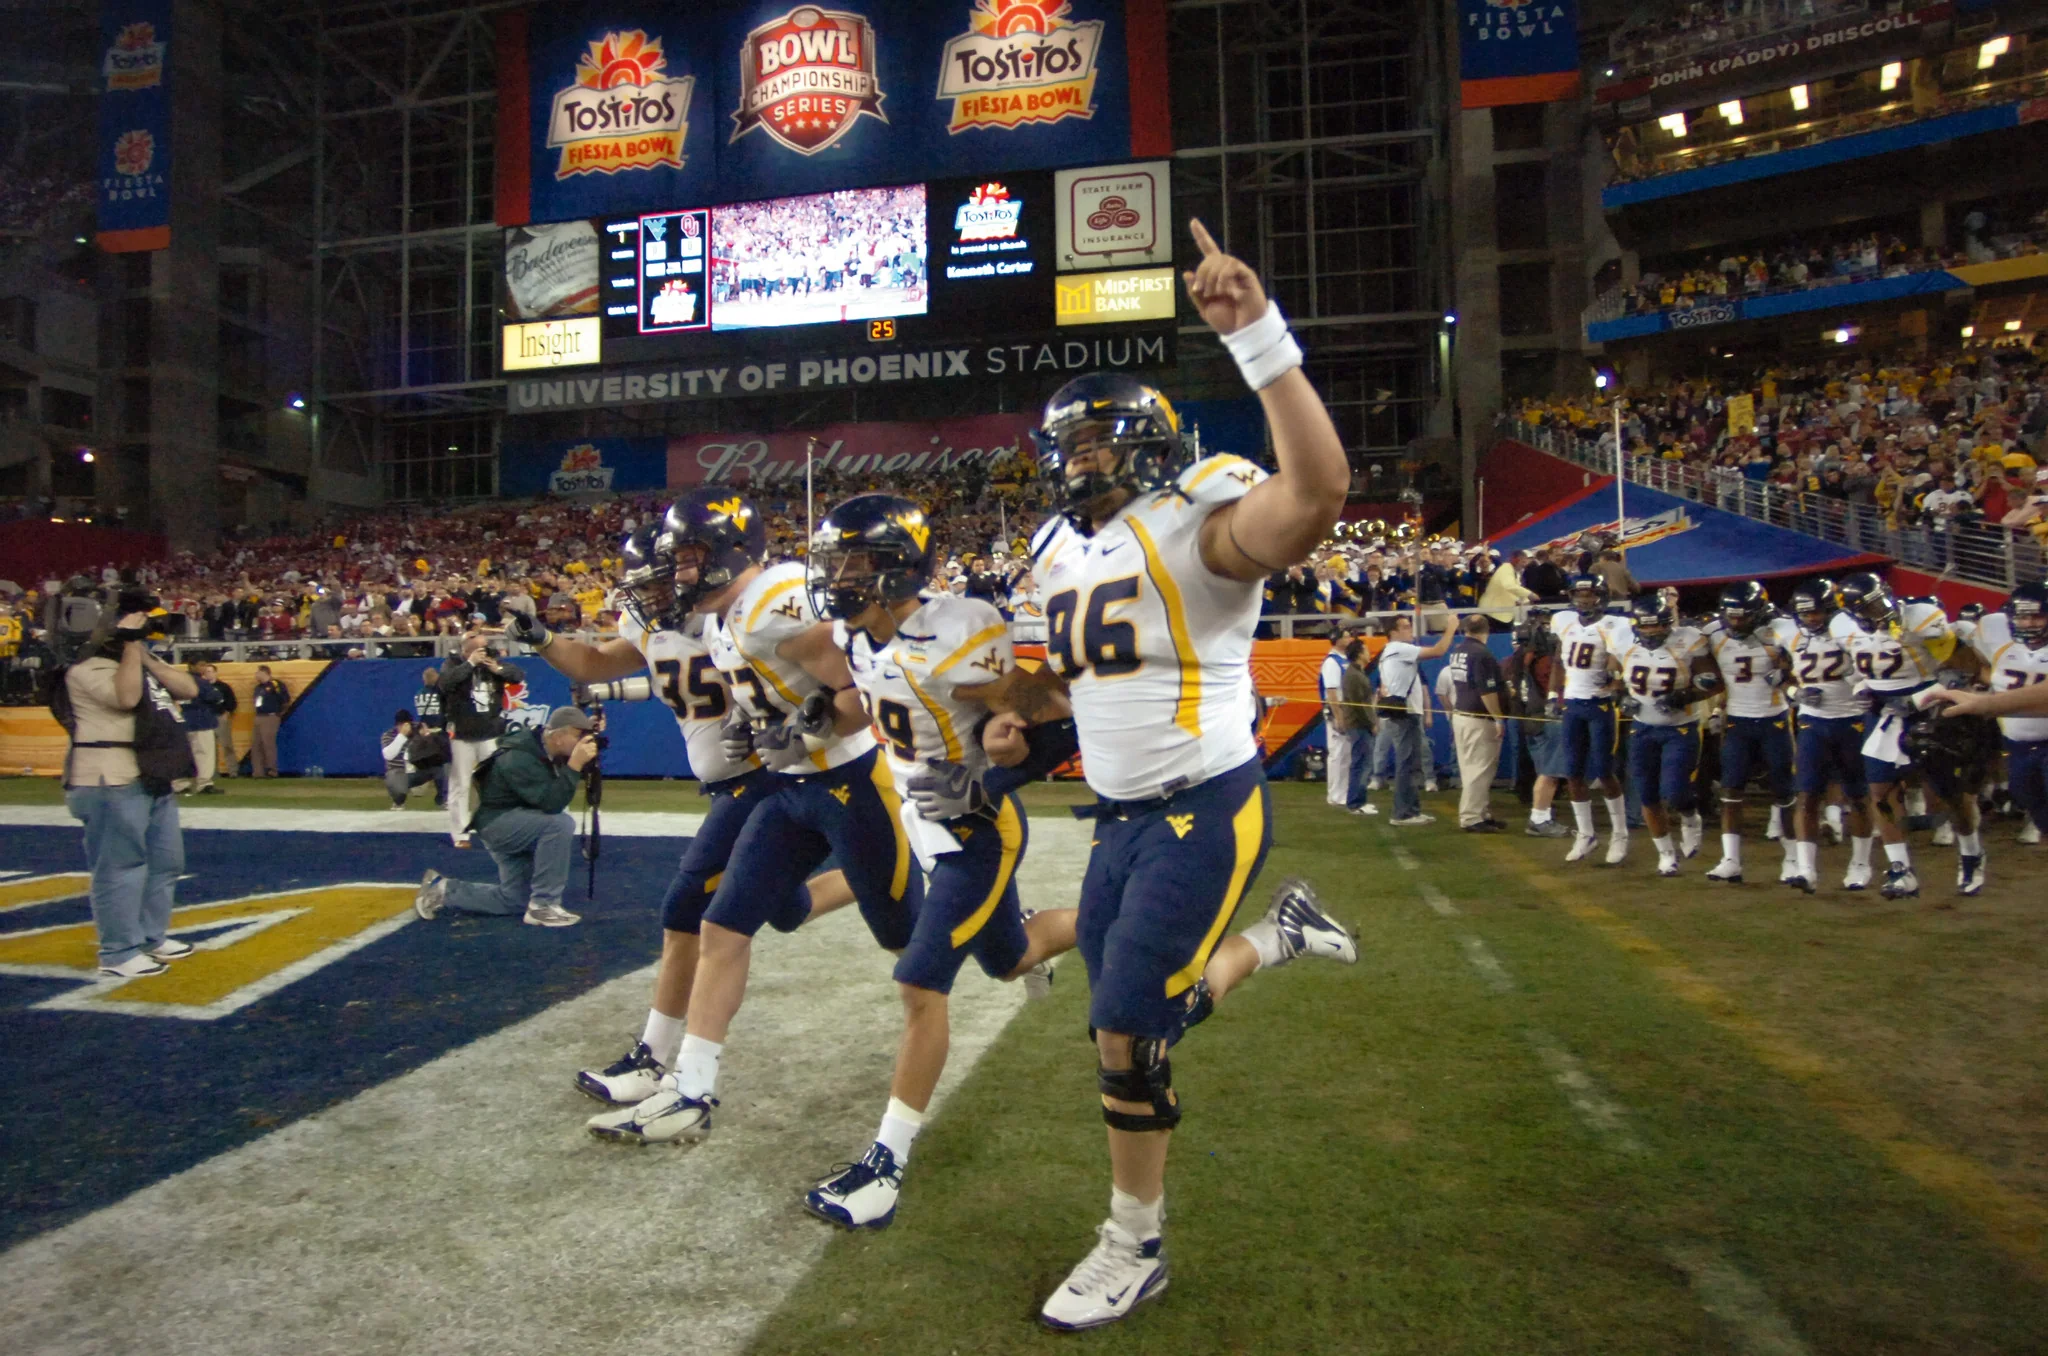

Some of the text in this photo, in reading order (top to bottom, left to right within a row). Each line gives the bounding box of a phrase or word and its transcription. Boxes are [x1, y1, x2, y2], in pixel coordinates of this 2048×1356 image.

[1469, 5, 1564, 26] FIESTA
[1479, 21, 1553, 40] BOWL
[760, 30, 857, 76] BOWL
[1649, 12, 1921, 89] JOHN (PADDY) DRISCOLL
[751, 71, 868, 107] CHAMPIONSHIP
[962, 87, 1083, 117] FIESTA BOWL
[774, 98, 847, 122] SERIES
[568, 136, 675, 164] FIESTA BOWL
[104, 174, 163, 188] FIESTA
[109, 187, 156, 200] BOWL
[1082, 183, 1143, 194] STATE FARM
[1083, 233, 1145, 244] INSURANCE
[1095, 297, 1141, 312] BANK
[520, 322, 581, 364] Insight
[871, 320, 894, 339] 25
[517, 337, 1165, 408] UNIVERSITY OF PHOENIX STADIUM
[1046, 571, 1143, 682] 96
[1568, 642, 1595, 669] 18
[1801, 650, 1844, 683] 22
[1631, 665, 1677, 697] 93
[1734, 656, 1752, 683] 3
[655, 654, 726, 719] 35
